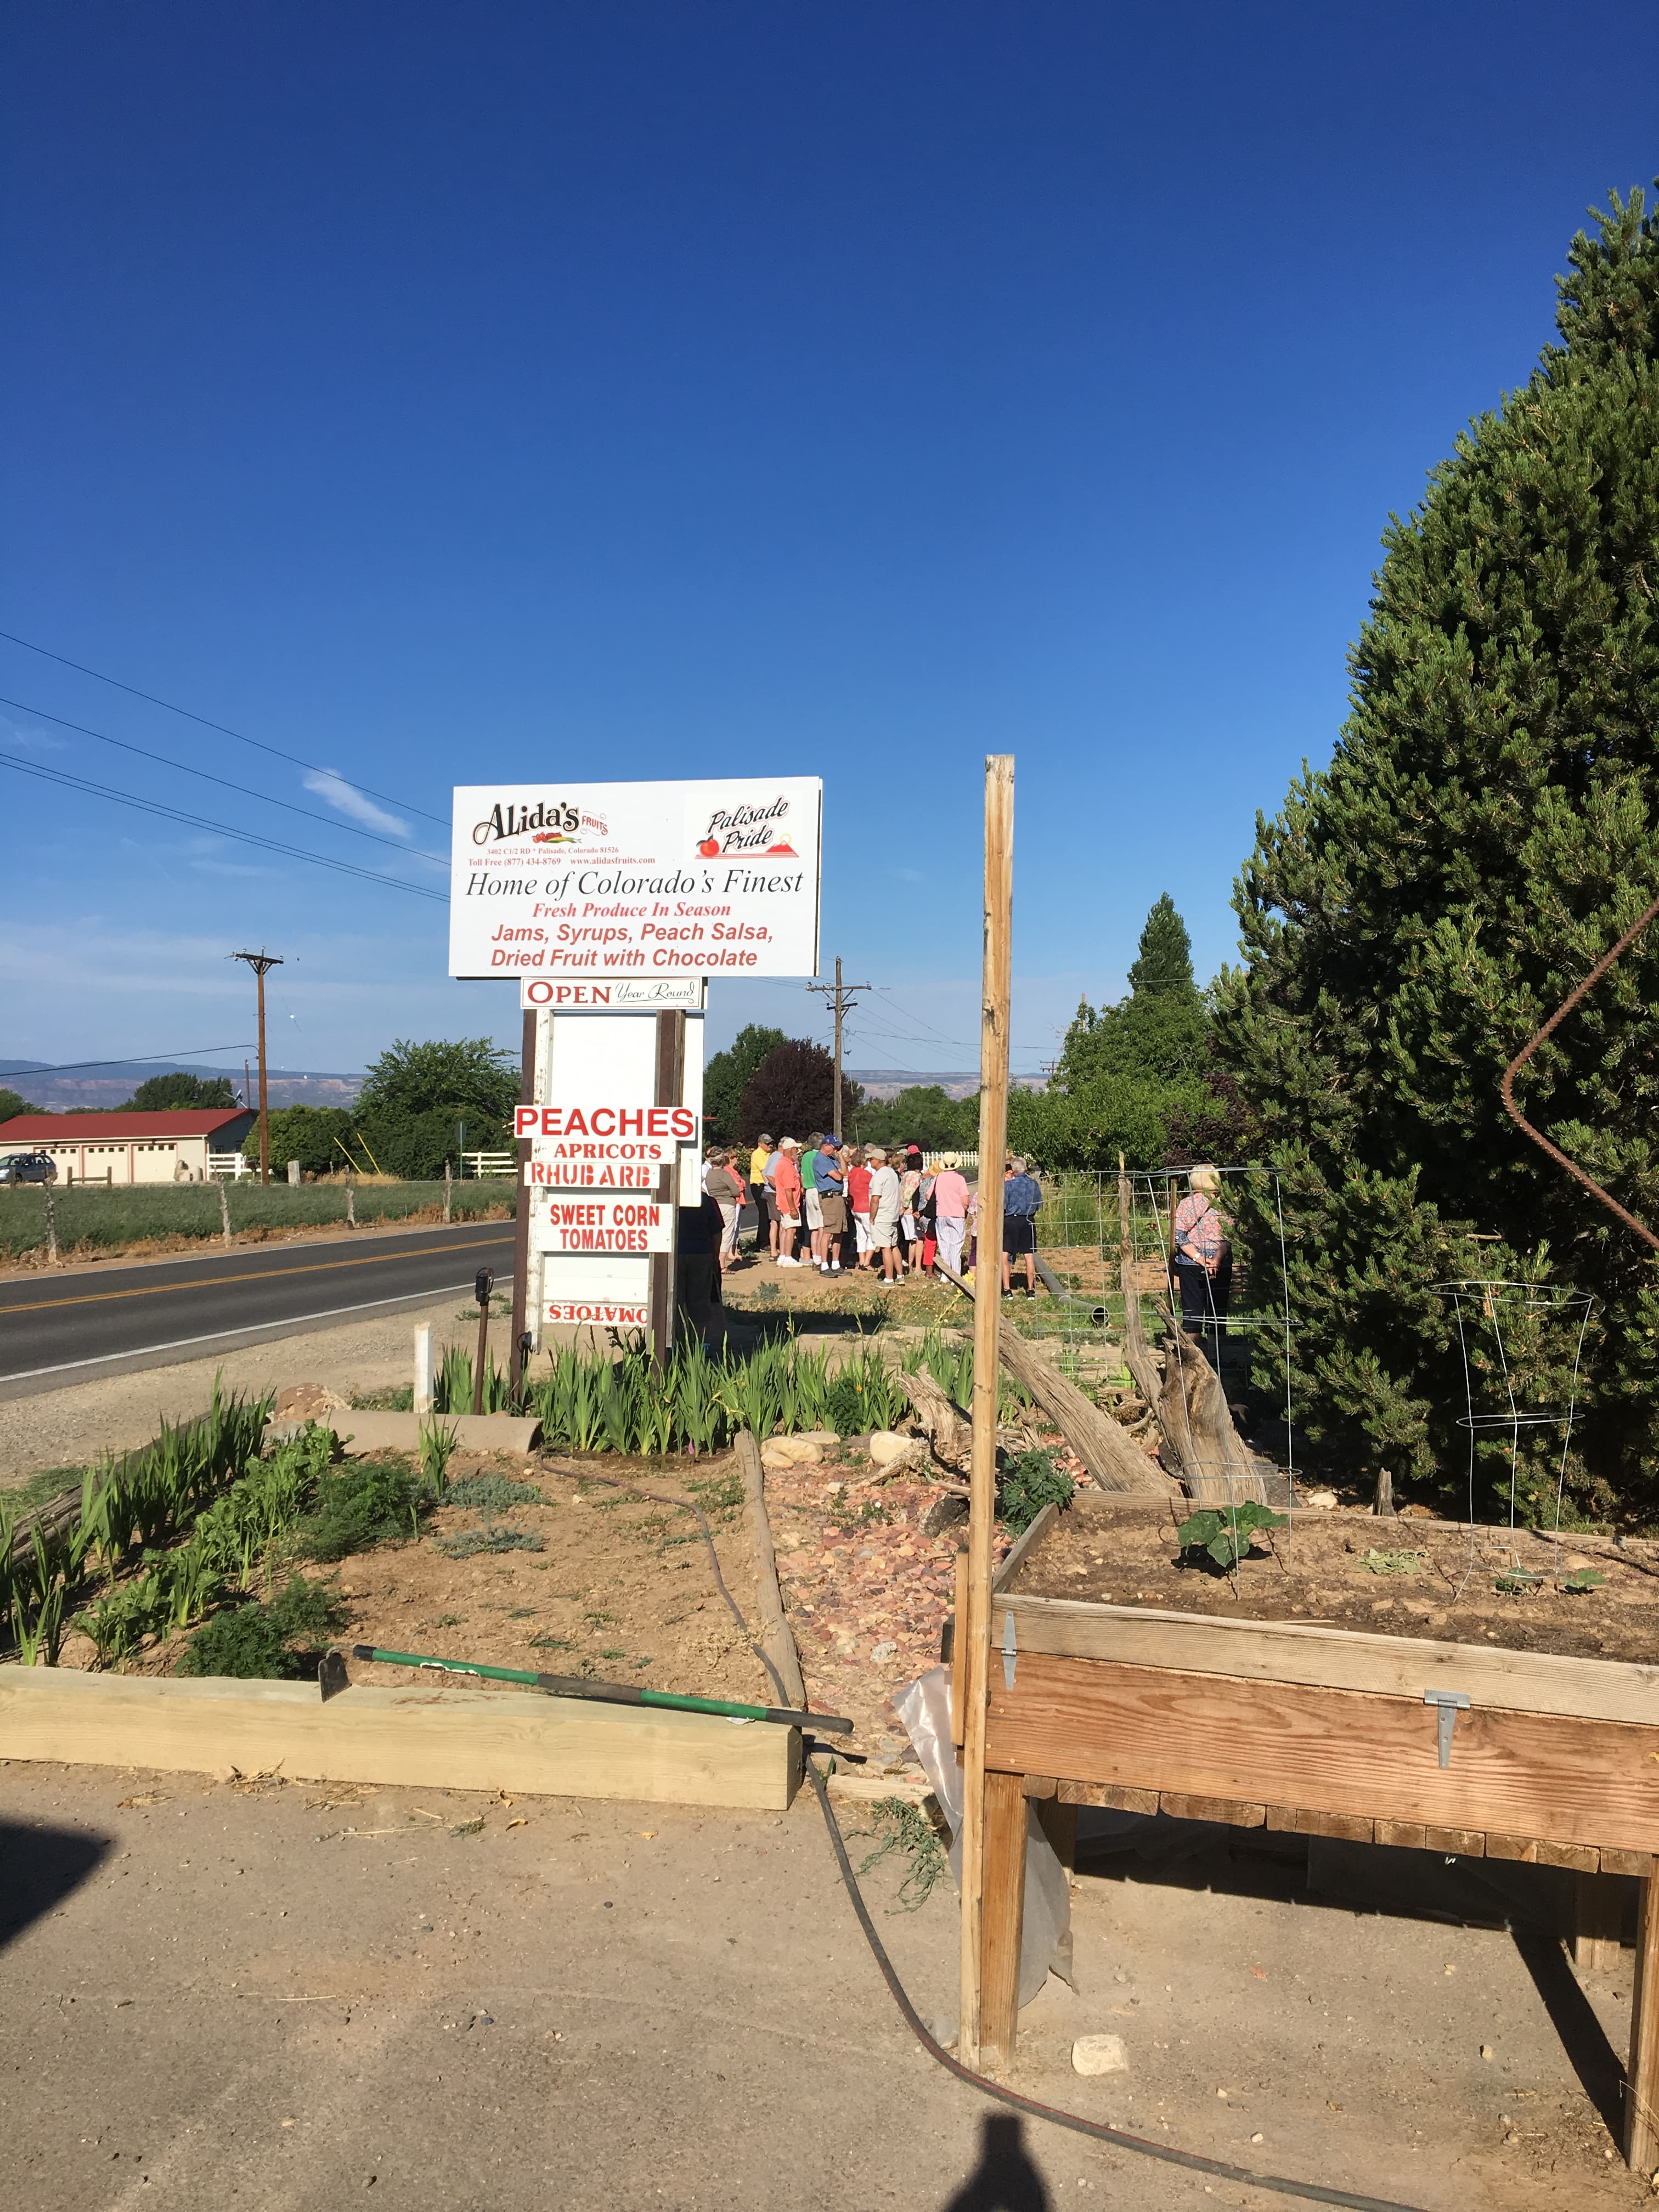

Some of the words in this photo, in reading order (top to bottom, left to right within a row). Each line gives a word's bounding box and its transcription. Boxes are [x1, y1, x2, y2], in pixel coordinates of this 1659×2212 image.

[582, 815, 608, 836] FRUITS
[707, 797, 788, 833] Palisade
[721, 824, 773, 853] Pride
[468, 858, 482, 866] Toll
[484, 858, 502, 866] Free
[504, 857, 524, 867] (877)
[570, 856, 656, 865] www.alidasfruits.com
[466, 873, 537, 895] Home
[546, 870, 575, 901] of
[578, 870, 714, 895] Colorado's
[723, 870, 804, 893] Finest
[533, 903, 576, 917] Fresh
[583, 902, 647, 917] Produce
[652, 902, 669, 916] In
[674, 902, 730, 916] Season
[492, 924, 548, 944] Jams,
[557, 924, 632, 945] Syrups,
[641, 923, 703, 940] Peach
[712, 923, 772, 943] Salsa,
[492, 950, 545, 966] Dried
[550, 949, 597, 966] Fruit
[604, 949, 645, 966] with
[653, 949, 757, 966] Chocolate
[528, 981, 611, 1003] OPEN
[615, 983, 645, 999] Year
[648, 980, 695, 1001] Round
[516, 1108, 694, 1137] PEACHES
[554, 1144, 661, 1159] APRICOTS
[531, 1162, 650, 1187] RHUBARB
[551, 1204, 605, 1225] SWEET
[613, 1205, 659, 1226] CORN
[560, 1229, 647, 1250] TOMATOES
[549, 1305, 648, 1324] OMATOES
